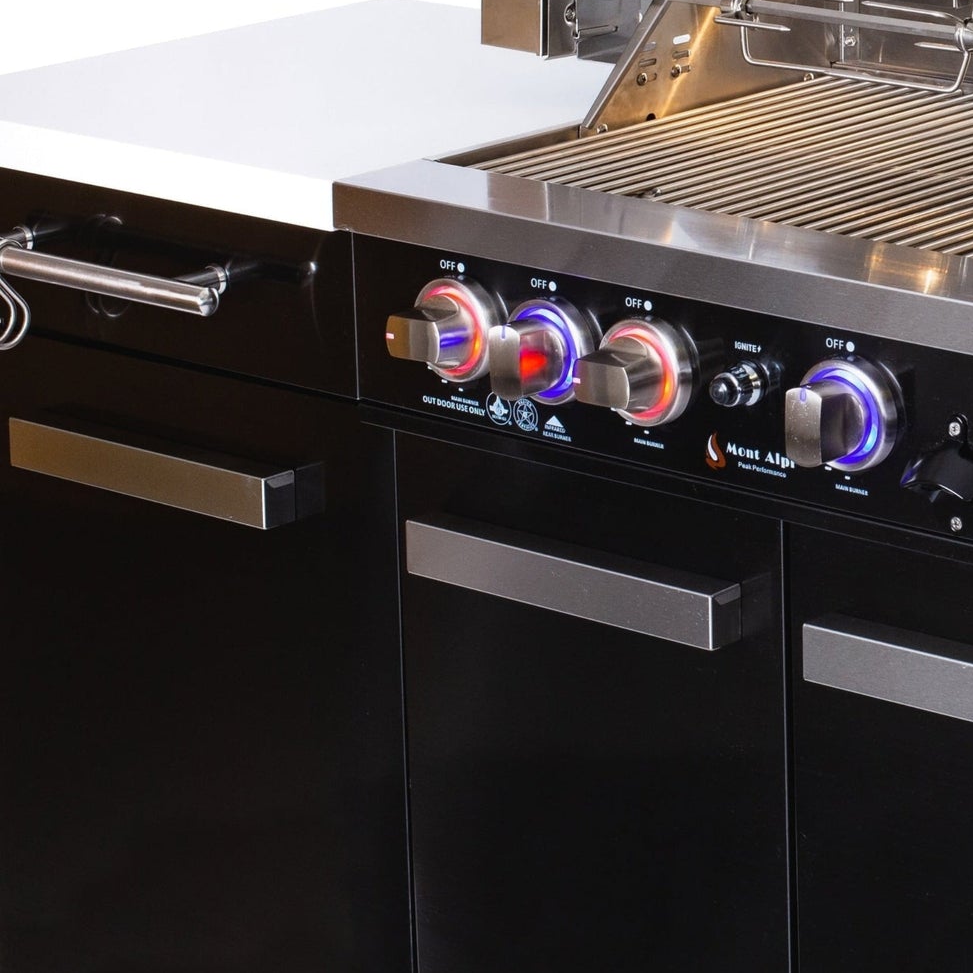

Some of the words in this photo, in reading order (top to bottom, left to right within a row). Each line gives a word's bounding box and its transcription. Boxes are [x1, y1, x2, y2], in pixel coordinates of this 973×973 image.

[440, 259, 456, 271] OFF
[531, 278, 547, 289] OFF
[625, 297, 642, 309] OFF
[735, 341, 757, 353] IGNITE
[826, 338, 844, 350] OFF
[423, 395, 436, 405] OUT
[437, 399, 456, 410] DOOR
[456, 403, 468, 413] USE
[469, 406, 486, 417] ONLY
[726, 442, 760, 460] Mont
[738, 461, 752, 470] Peak
[753, 465, 787, 478] Performance
